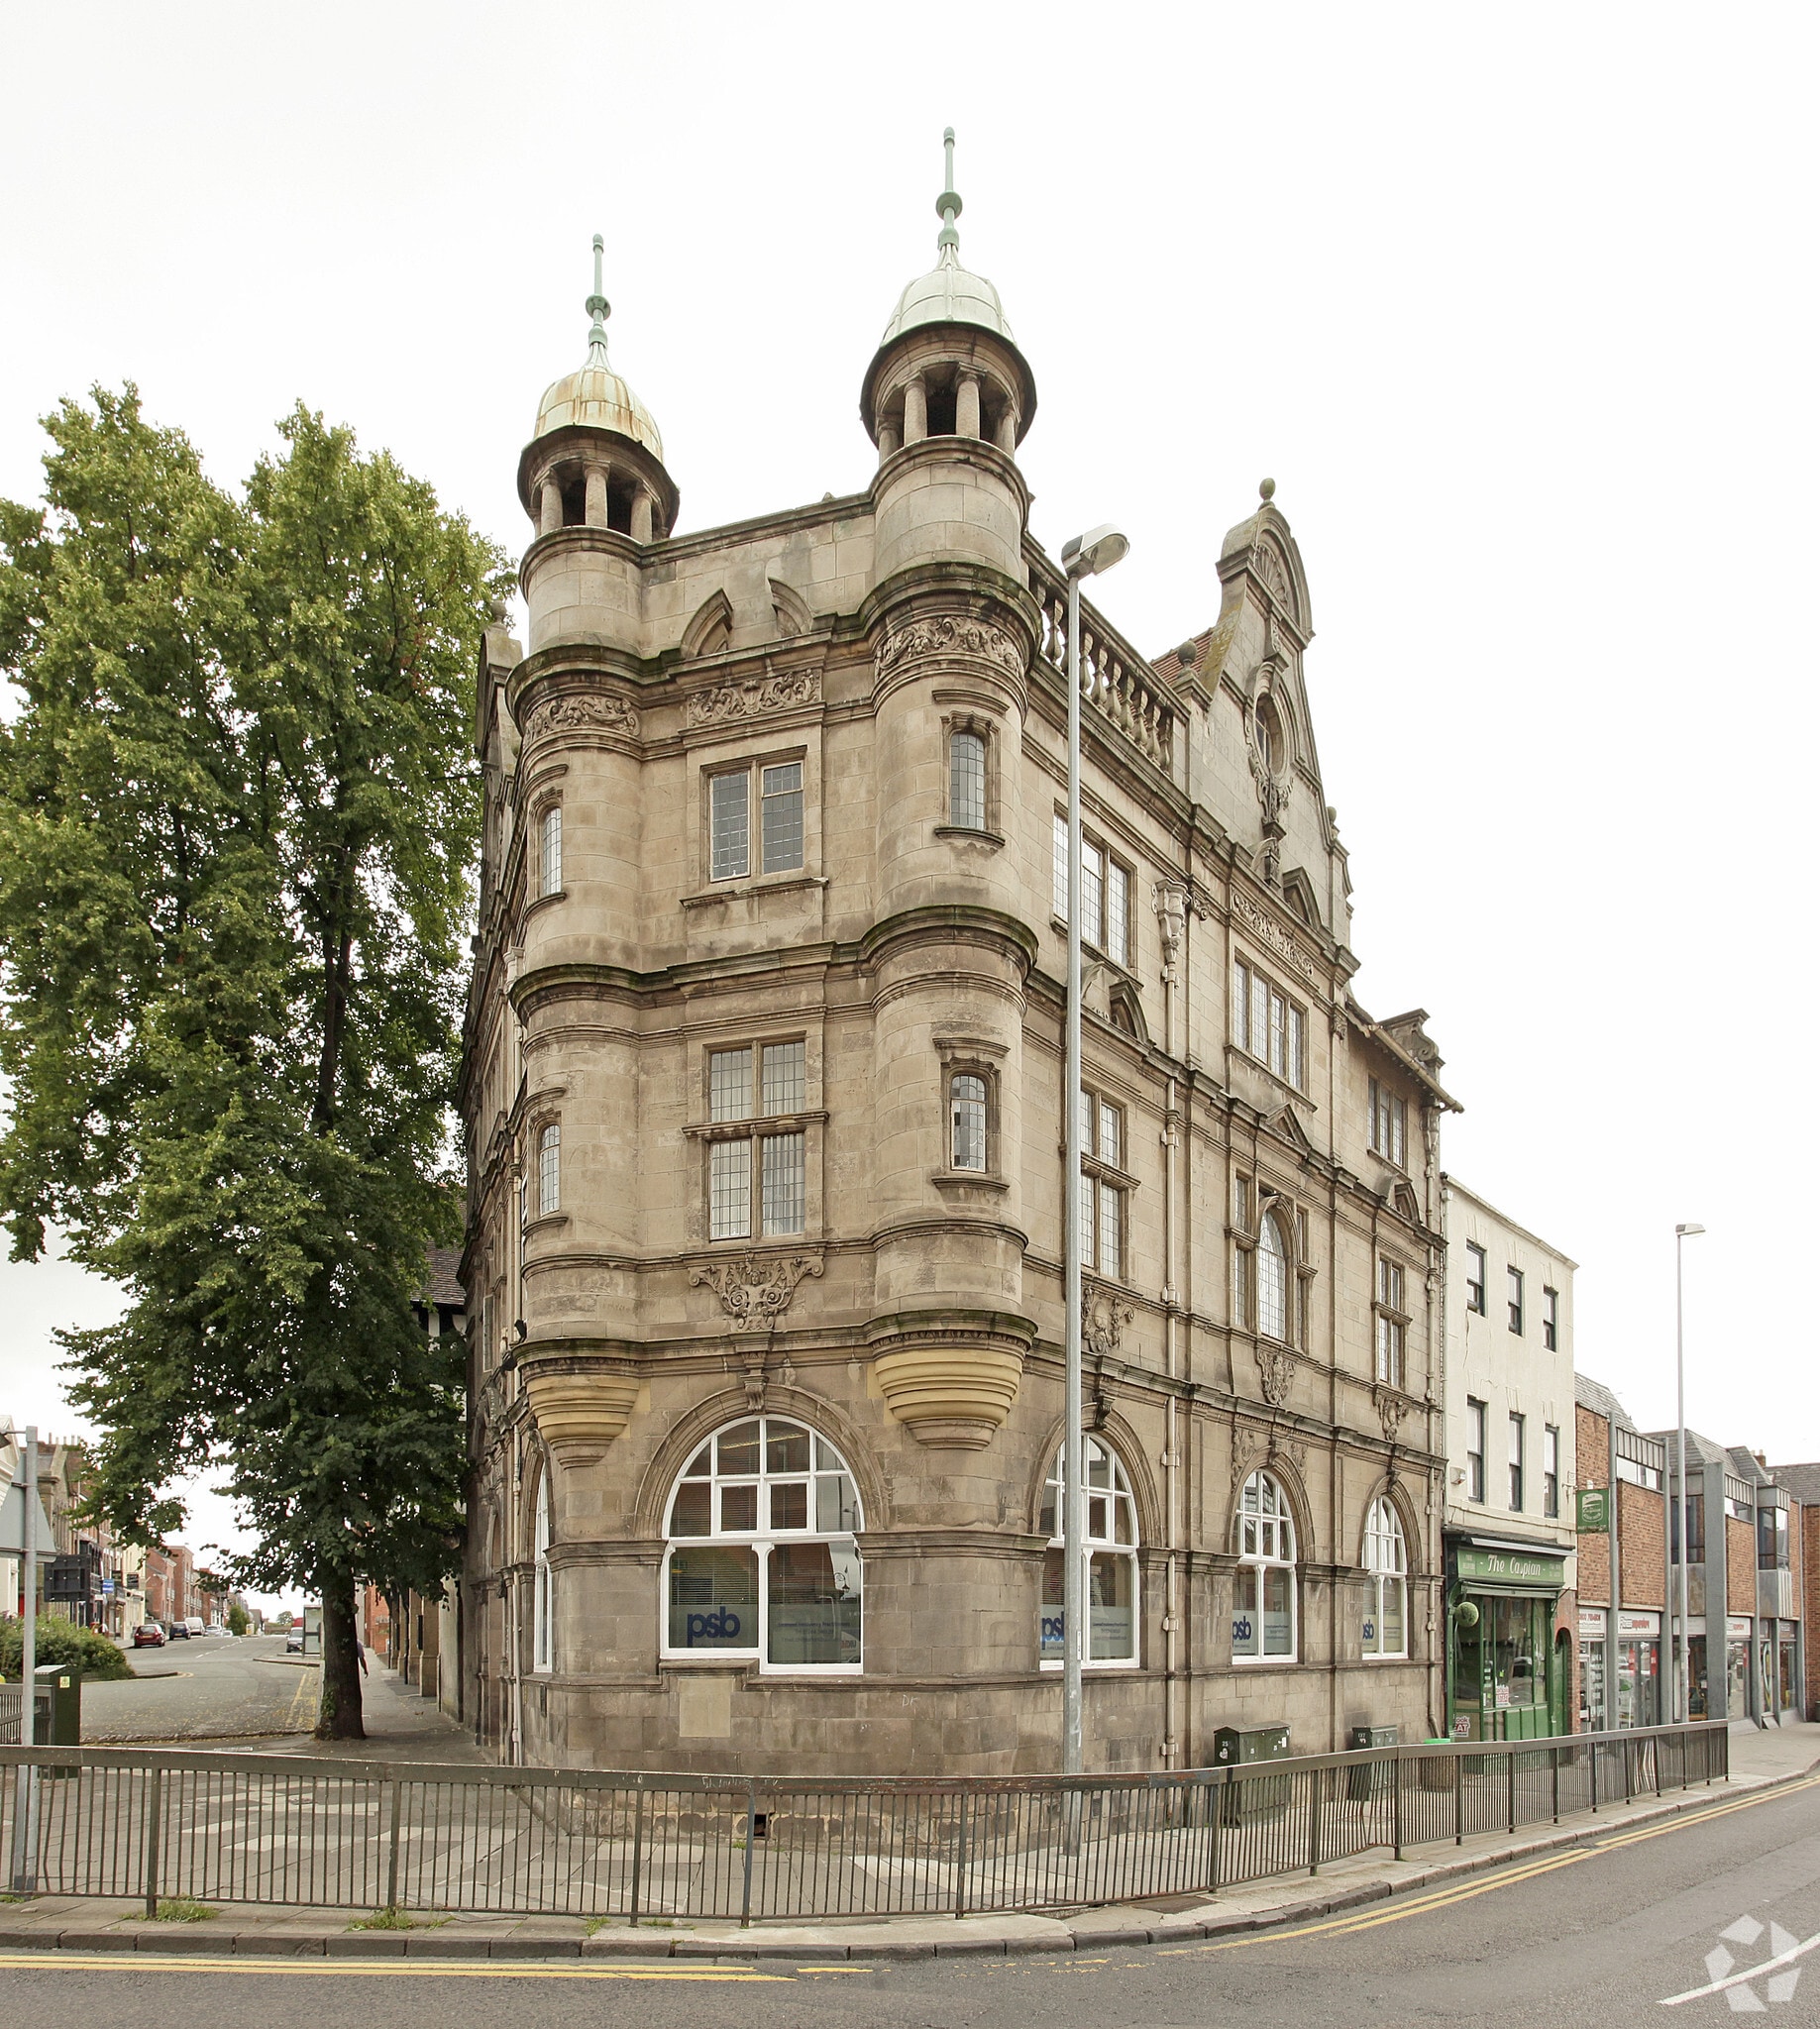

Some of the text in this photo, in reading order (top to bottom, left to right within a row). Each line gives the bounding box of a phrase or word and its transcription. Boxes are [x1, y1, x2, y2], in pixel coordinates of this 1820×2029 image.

[1487, 1554, 1505, 1572] The
[1510, 1556, 1541, 1579] Caspian
[687, 1606, 741, 1648] psb
[1363, 1619, 1375, 1640] sb
